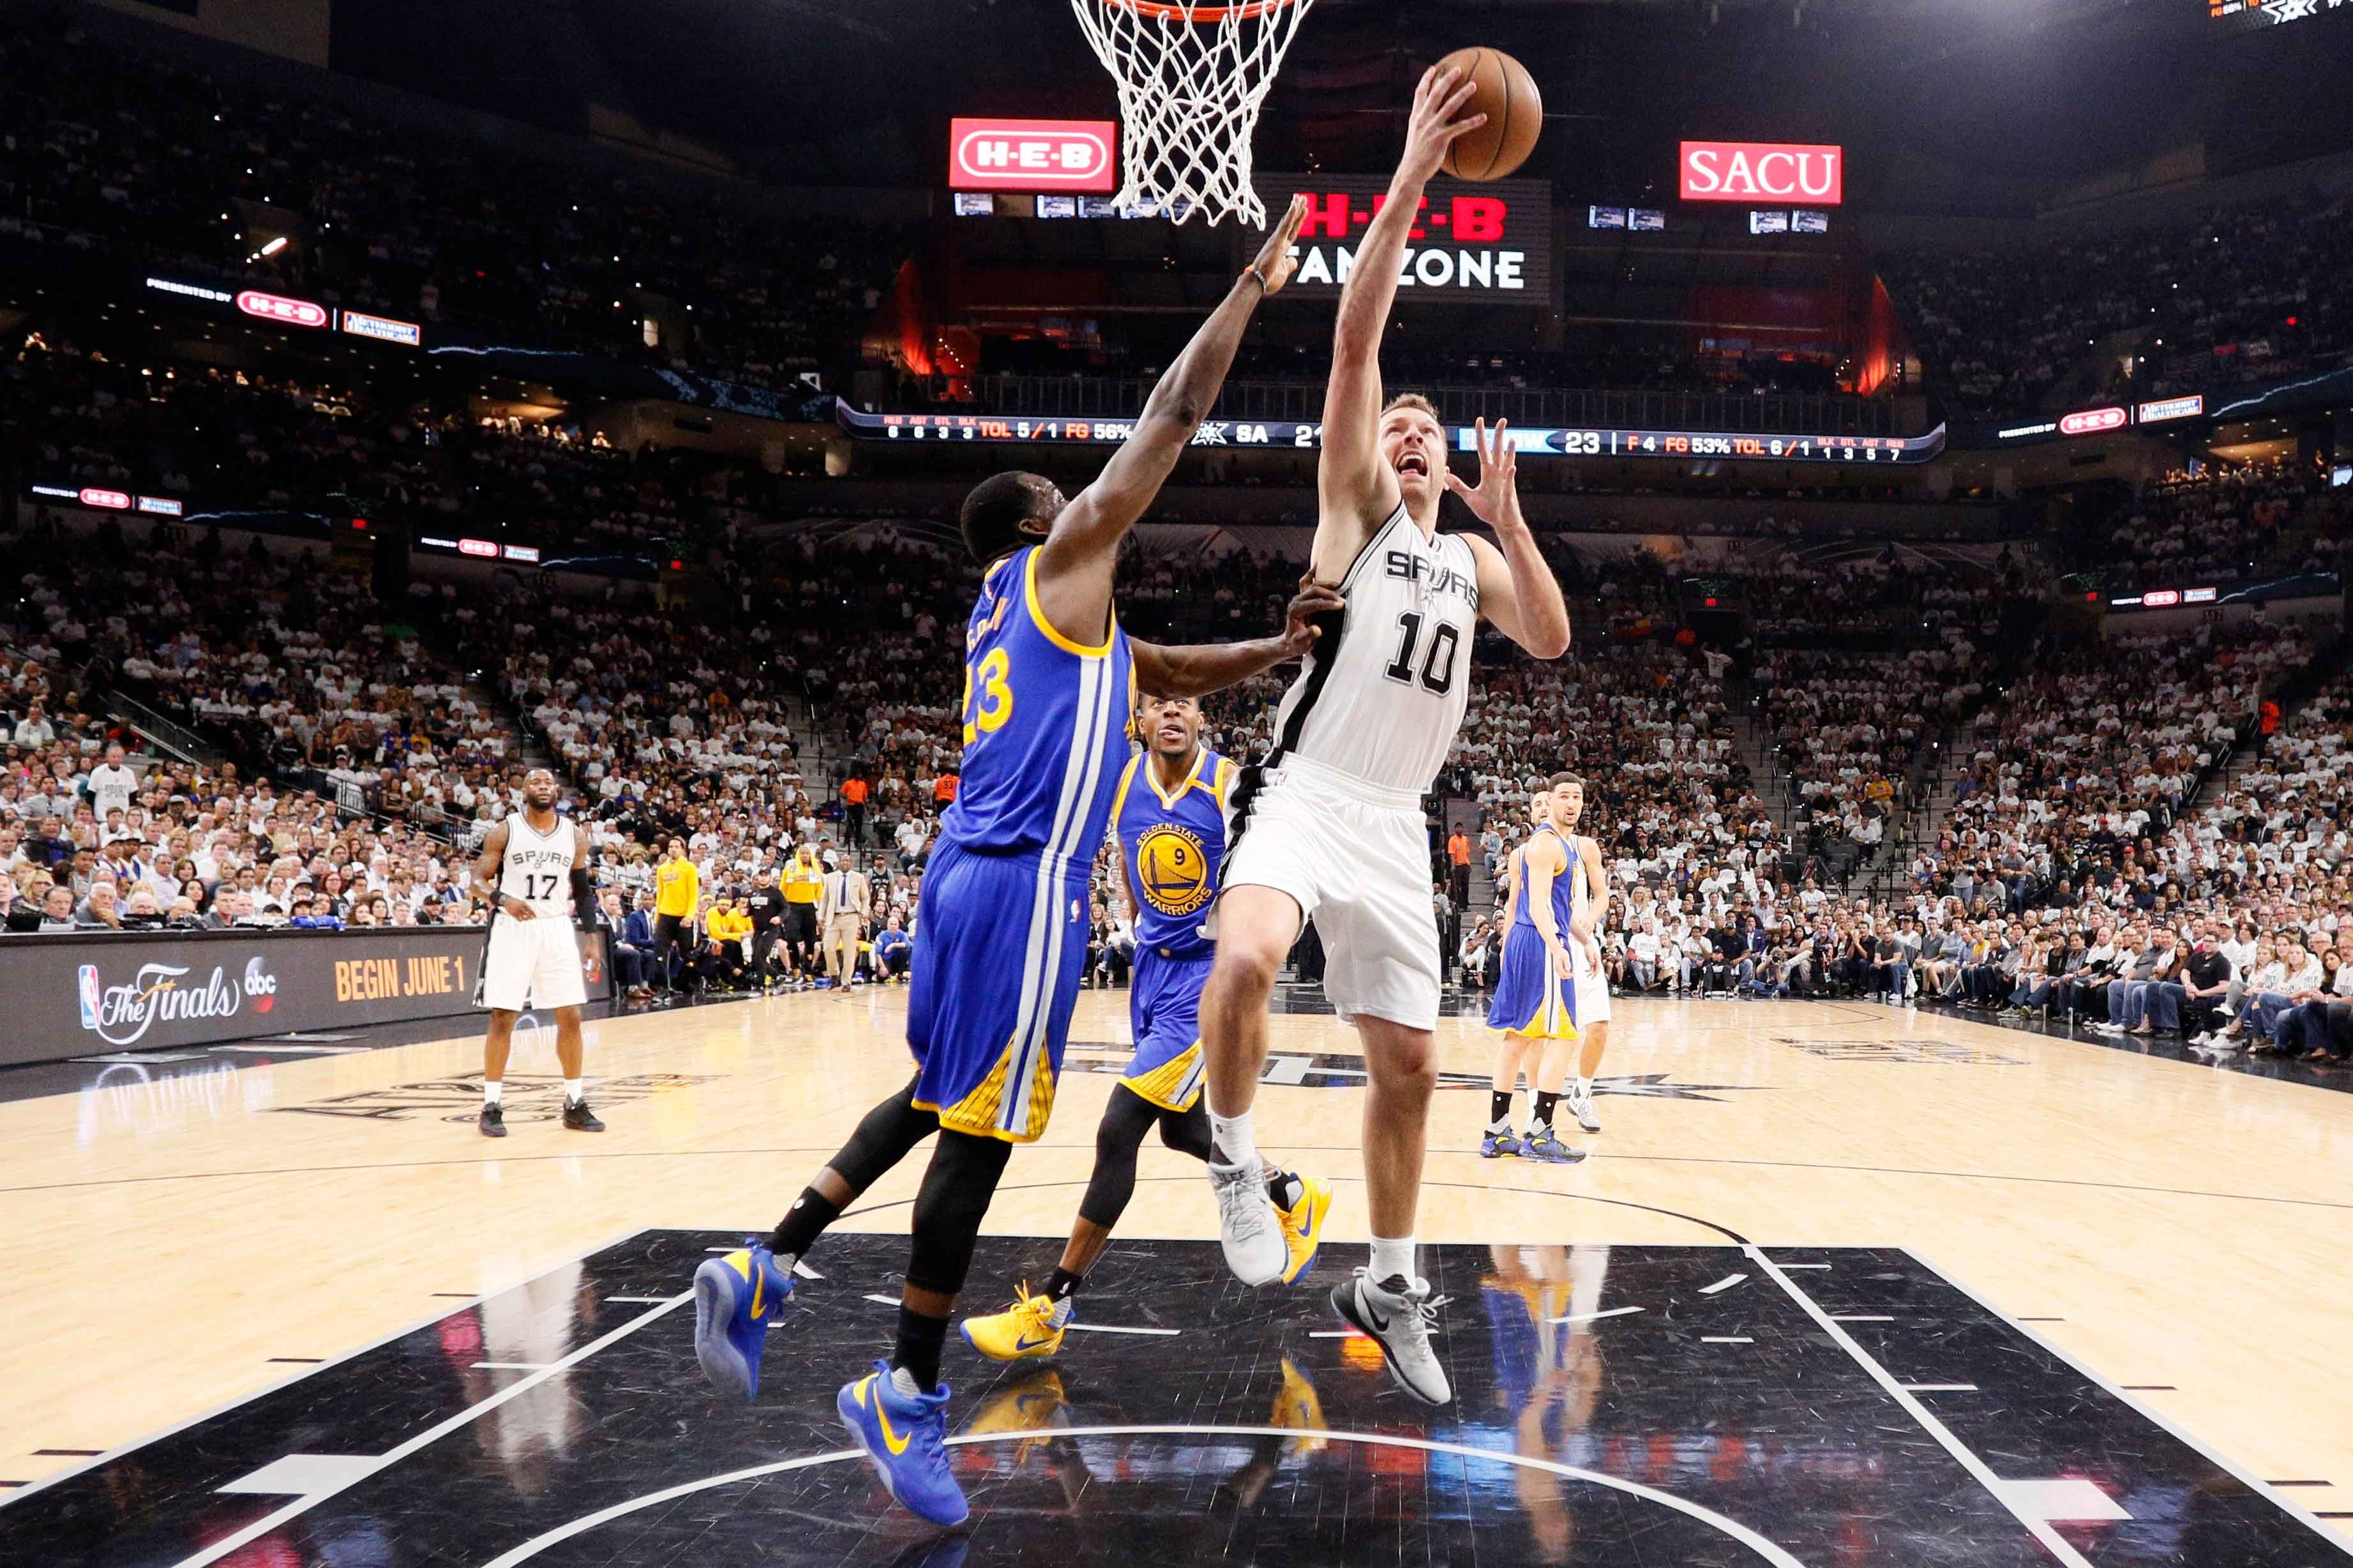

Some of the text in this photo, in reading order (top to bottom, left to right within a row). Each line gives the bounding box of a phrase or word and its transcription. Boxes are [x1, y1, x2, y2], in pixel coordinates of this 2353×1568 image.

[977, 141, 1092, 168] H-E-B
[1688, 150, 1835, 195] SACU
[216, 292, 232, 302] BY
[249, 297, 319, 321] H-E-B
[888, 425, 973, 440] 6 6 3 3
[980, 422, 1011, 437] TOL
[1065, 422, 1088, 438] FG
[1094, 423, 1132, 440] 56%
[1236, 424, 1268, 443] SA
[1565, 431, 1599, 454] 23
[1862, 438, 1879, 447] AST
[1999, 426, 2044, 438] PRESENTED
[1628, 435, 1639, 451] F
[1643, 435, 1655, 452] 4
[1665, 437, 1687, 452] FG
[1692, 438, 1730, 454] 53%
[1733, 438, 1765, 454] TOL
[1823, 447, 1900, 461] 1 3 5 7
[1385, 551, 1478, 613] SPURS
[1383, 609, 1460, 698] 10
[1136, 823, 1204, 847] GOLDEN STATE
[513, 851, 571, 868] SPURS
[1175, 848, 1185, 865] 9
[525, 874, 557, 900] 17
[1144, 887, 1212, 915] WARRIORS
[244, 970, 276, 996] abc
[335, 955, 465, 1002] BEGIN JUNE 1
[100, 983, 146, 1026] The
